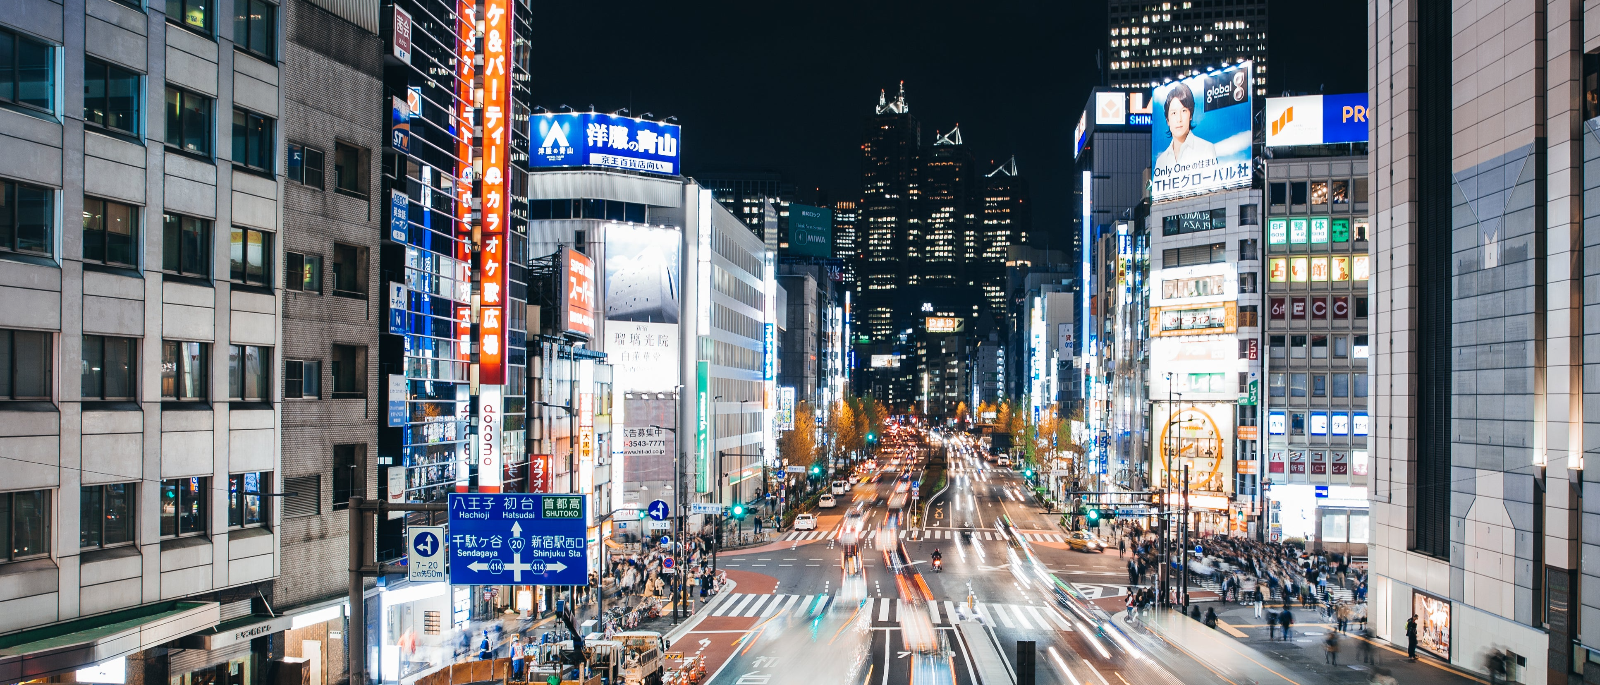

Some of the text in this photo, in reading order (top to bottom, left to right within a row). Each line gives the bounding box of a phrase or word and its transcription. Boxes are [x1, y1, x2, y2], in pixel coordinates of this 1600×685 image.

[1206, 81, 1232, 104] global
[1342, 105, 1369, 123] PR
[586, 122, 677, 157] 洋服の青山
[1154, 157, 1219, 177] Only One の住まい
[1154, 163, 1249, 191] THEグローバル社
[807, 234, 826, 244] MIWA
[453, 497, 581, 511] 八王子 初台 首都高
[459, 510, 579, 520] Hachioji Hatsudai SHUTOKO
[511, 541, 522, 549] 20
[531, 535, 584, 548] 新宿駅西口
[457, 549, 498, 558] Sendagaya
[533, 549, 583, 558] Shinjuku Sta.
[490, 562, 502, 571] 414
[532, 562, 544, 571] 414
[411, 569, 443, 578] この先50m
